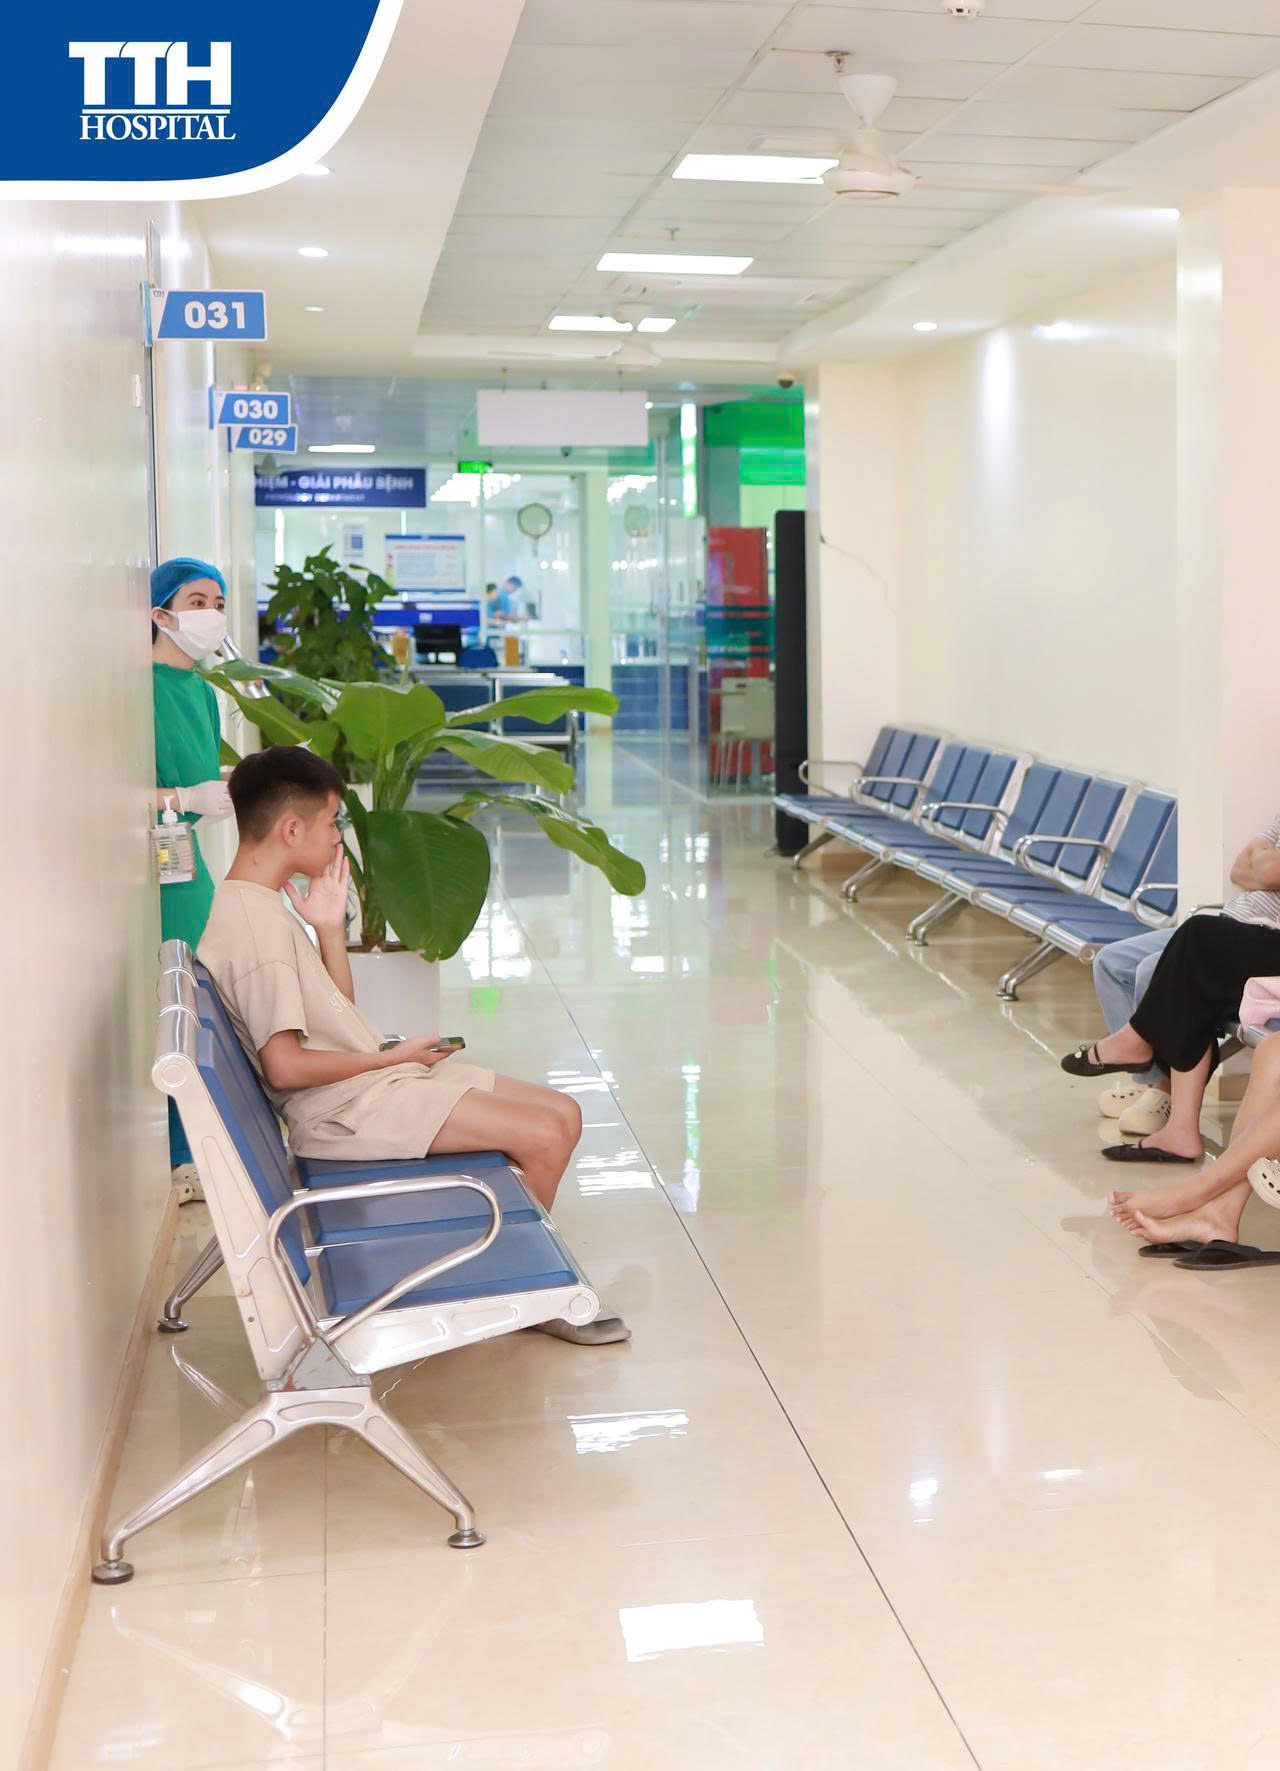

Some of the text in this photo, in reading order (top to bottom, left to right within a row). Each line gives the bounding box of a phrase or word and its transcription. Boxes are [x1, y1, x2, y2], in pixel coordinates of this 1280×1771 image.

[184, 300, 246, 329] 031
[233, 399, 279, 419] 030
[249, 428, 287, 446] 029
